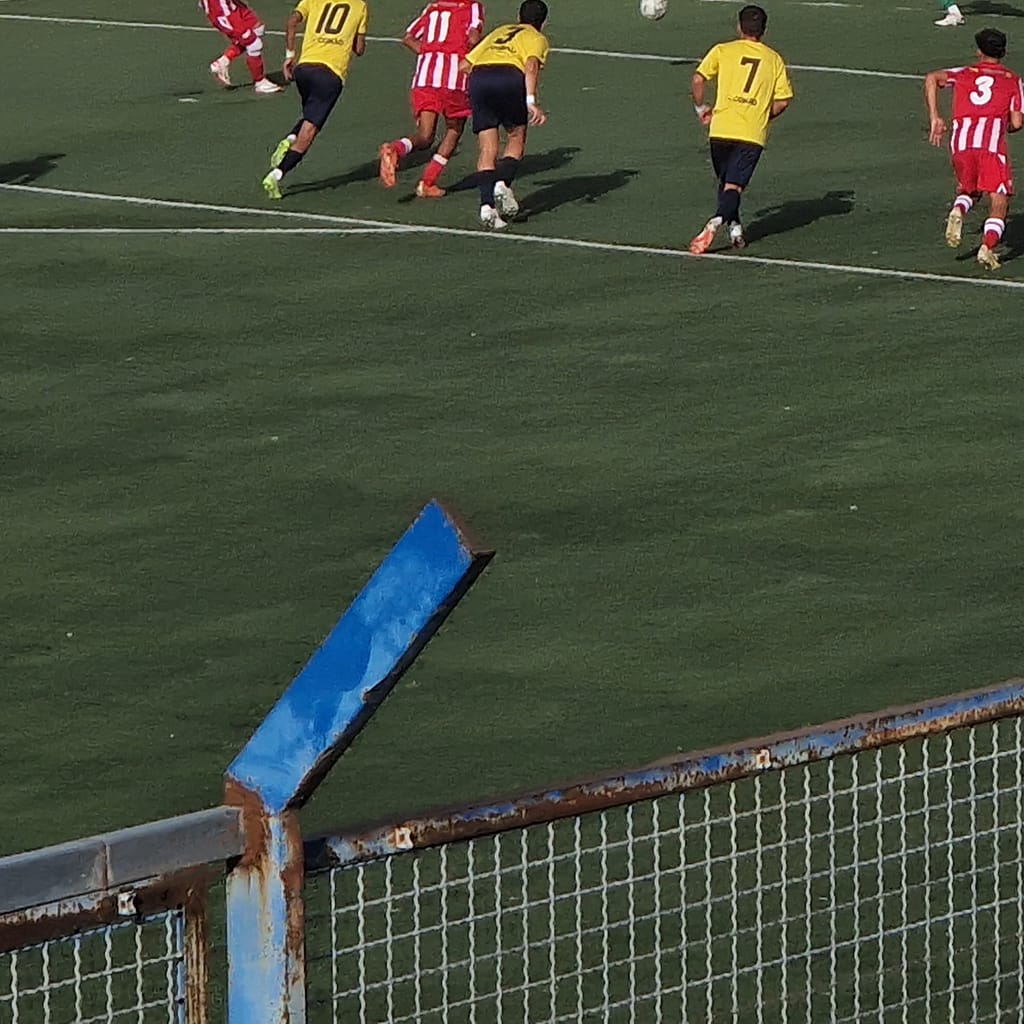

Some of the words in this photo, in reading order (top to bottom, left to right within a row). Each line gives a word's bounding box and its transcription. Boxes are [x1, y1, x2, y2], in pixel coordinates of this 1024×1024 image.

[315, 2, 351, 35] 10
[427, 10, 452, 43] 11
[740, 56, 762, 94] 7
[969, 75, 995, 105] 3
